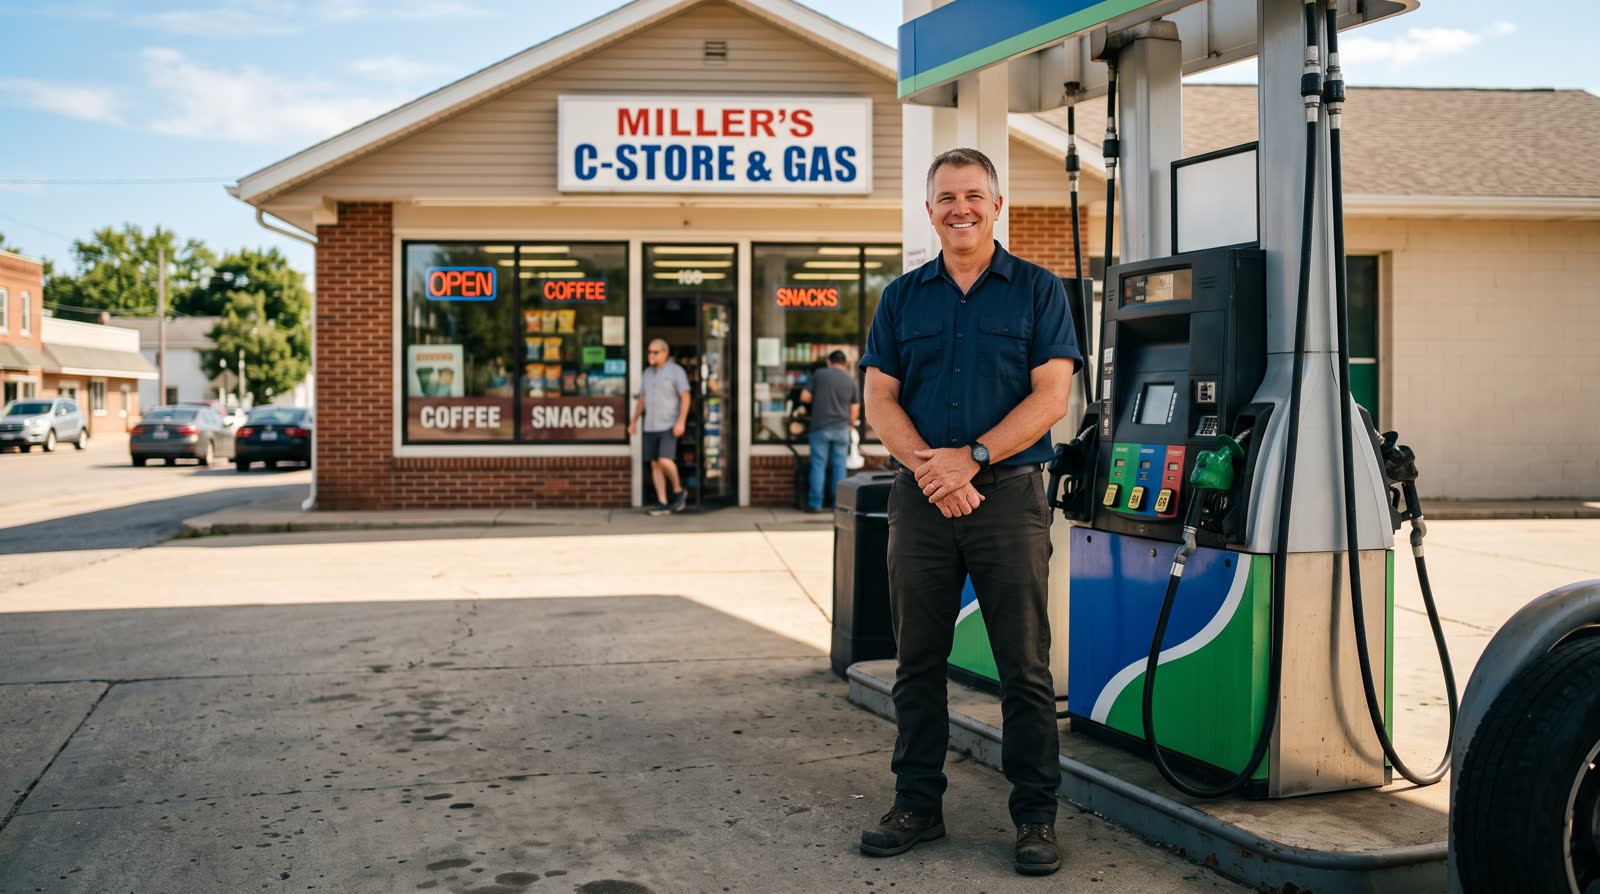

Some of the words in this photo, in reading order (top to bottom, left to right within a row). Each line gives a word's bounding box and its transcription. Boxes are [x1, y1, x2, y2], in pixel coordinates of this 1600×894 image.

[618, 108, 814, 138] MILLER'S
[574, 144, 735, 181] C-STORE
[746, 151, 772, 182] &
[784, 145, 856, 182] GAS
[429, 271, 493, 297] OPEN
[543, 281, 606, 300] COFFEE
[776, 288, 838, 308] SNACKS
[421, 407, 499, 428] COFFEE
[533, 407, 613, 427] SNACKS
